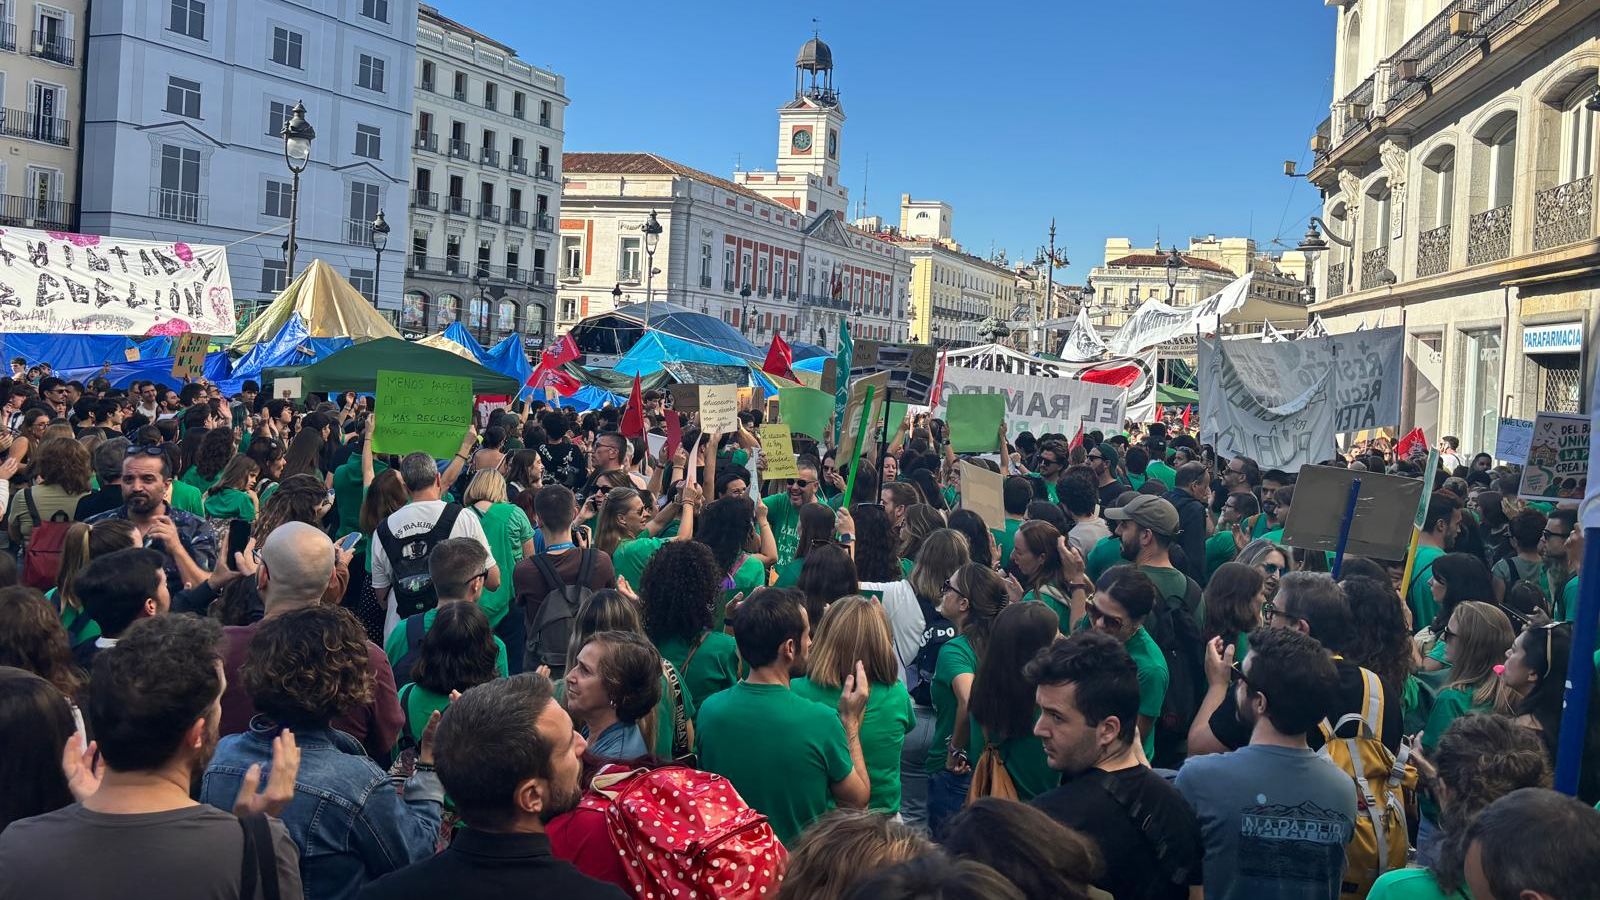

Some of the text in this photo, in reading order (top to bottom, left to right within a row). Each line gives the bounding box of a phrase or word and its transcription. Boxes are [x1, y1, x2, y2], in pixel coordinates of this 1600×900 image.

[1524, 328, 1582, 348] PARAFARMACIA
[387, 377, 424, 391] MENOS
[416, 414, 466, 423] RECURSOS
[1501, 418, 1533, 428] HUELGA
[1561, 425, 1579, 435] DEL
[1555, 463, 1579, 473] CREA
[937, 627, 955, 637] DO
